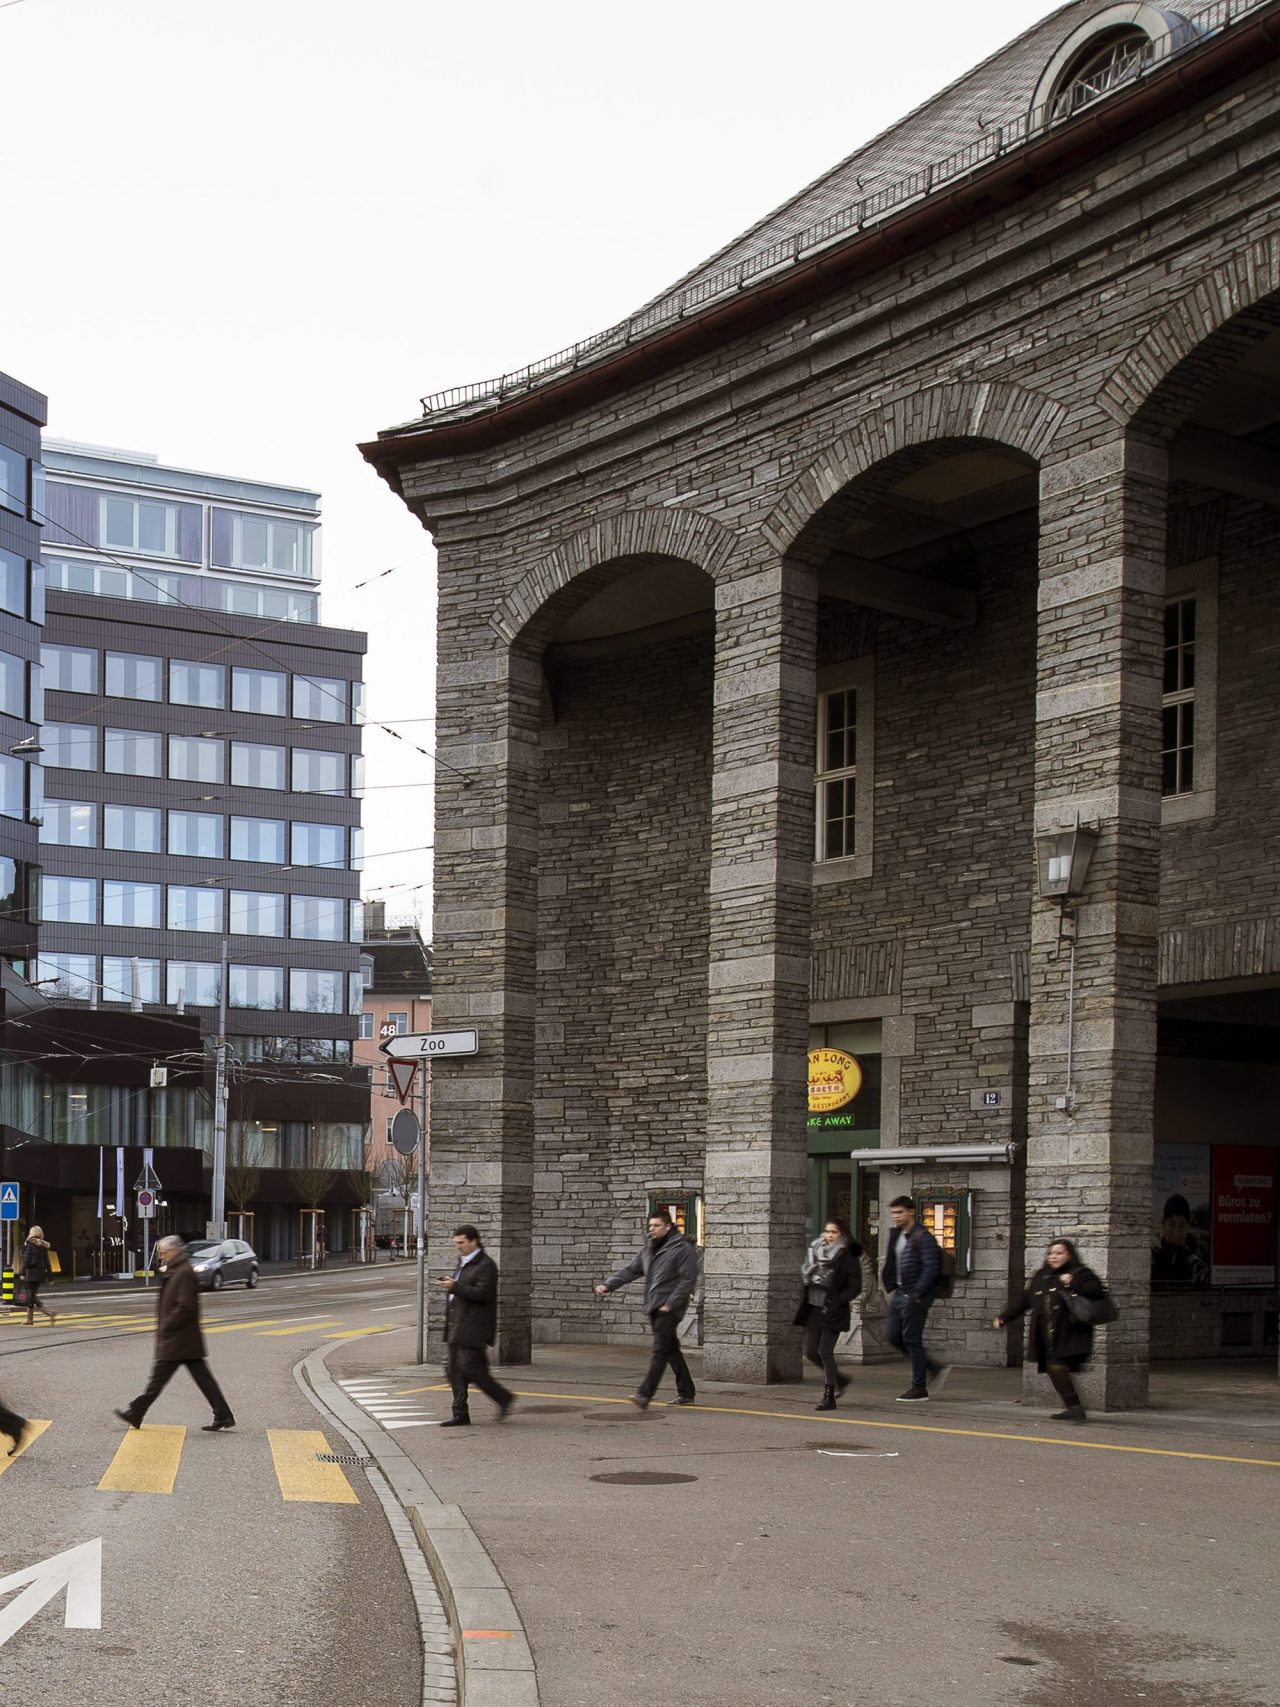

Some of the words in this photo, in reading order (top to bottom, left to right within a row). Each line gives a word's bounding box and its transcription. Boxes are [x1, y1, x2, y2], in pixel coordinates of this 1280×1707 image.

[380, 1025, 396, 1036] 48
[420, 1038, 445, 1051] Zoo
[824, 1052, 852, 1071] LONG
[813, 1093, 851, 1109] RESTAURANT
[986, 1093, 996, 1104] 12
[825, 1116, 852, 1126] AWAY
[1218, 1195, 1247, 1208] Büros
[1249, 1198, 1261, 1208] zu
[1217, 1211, 1272, 1224] vermieten?
